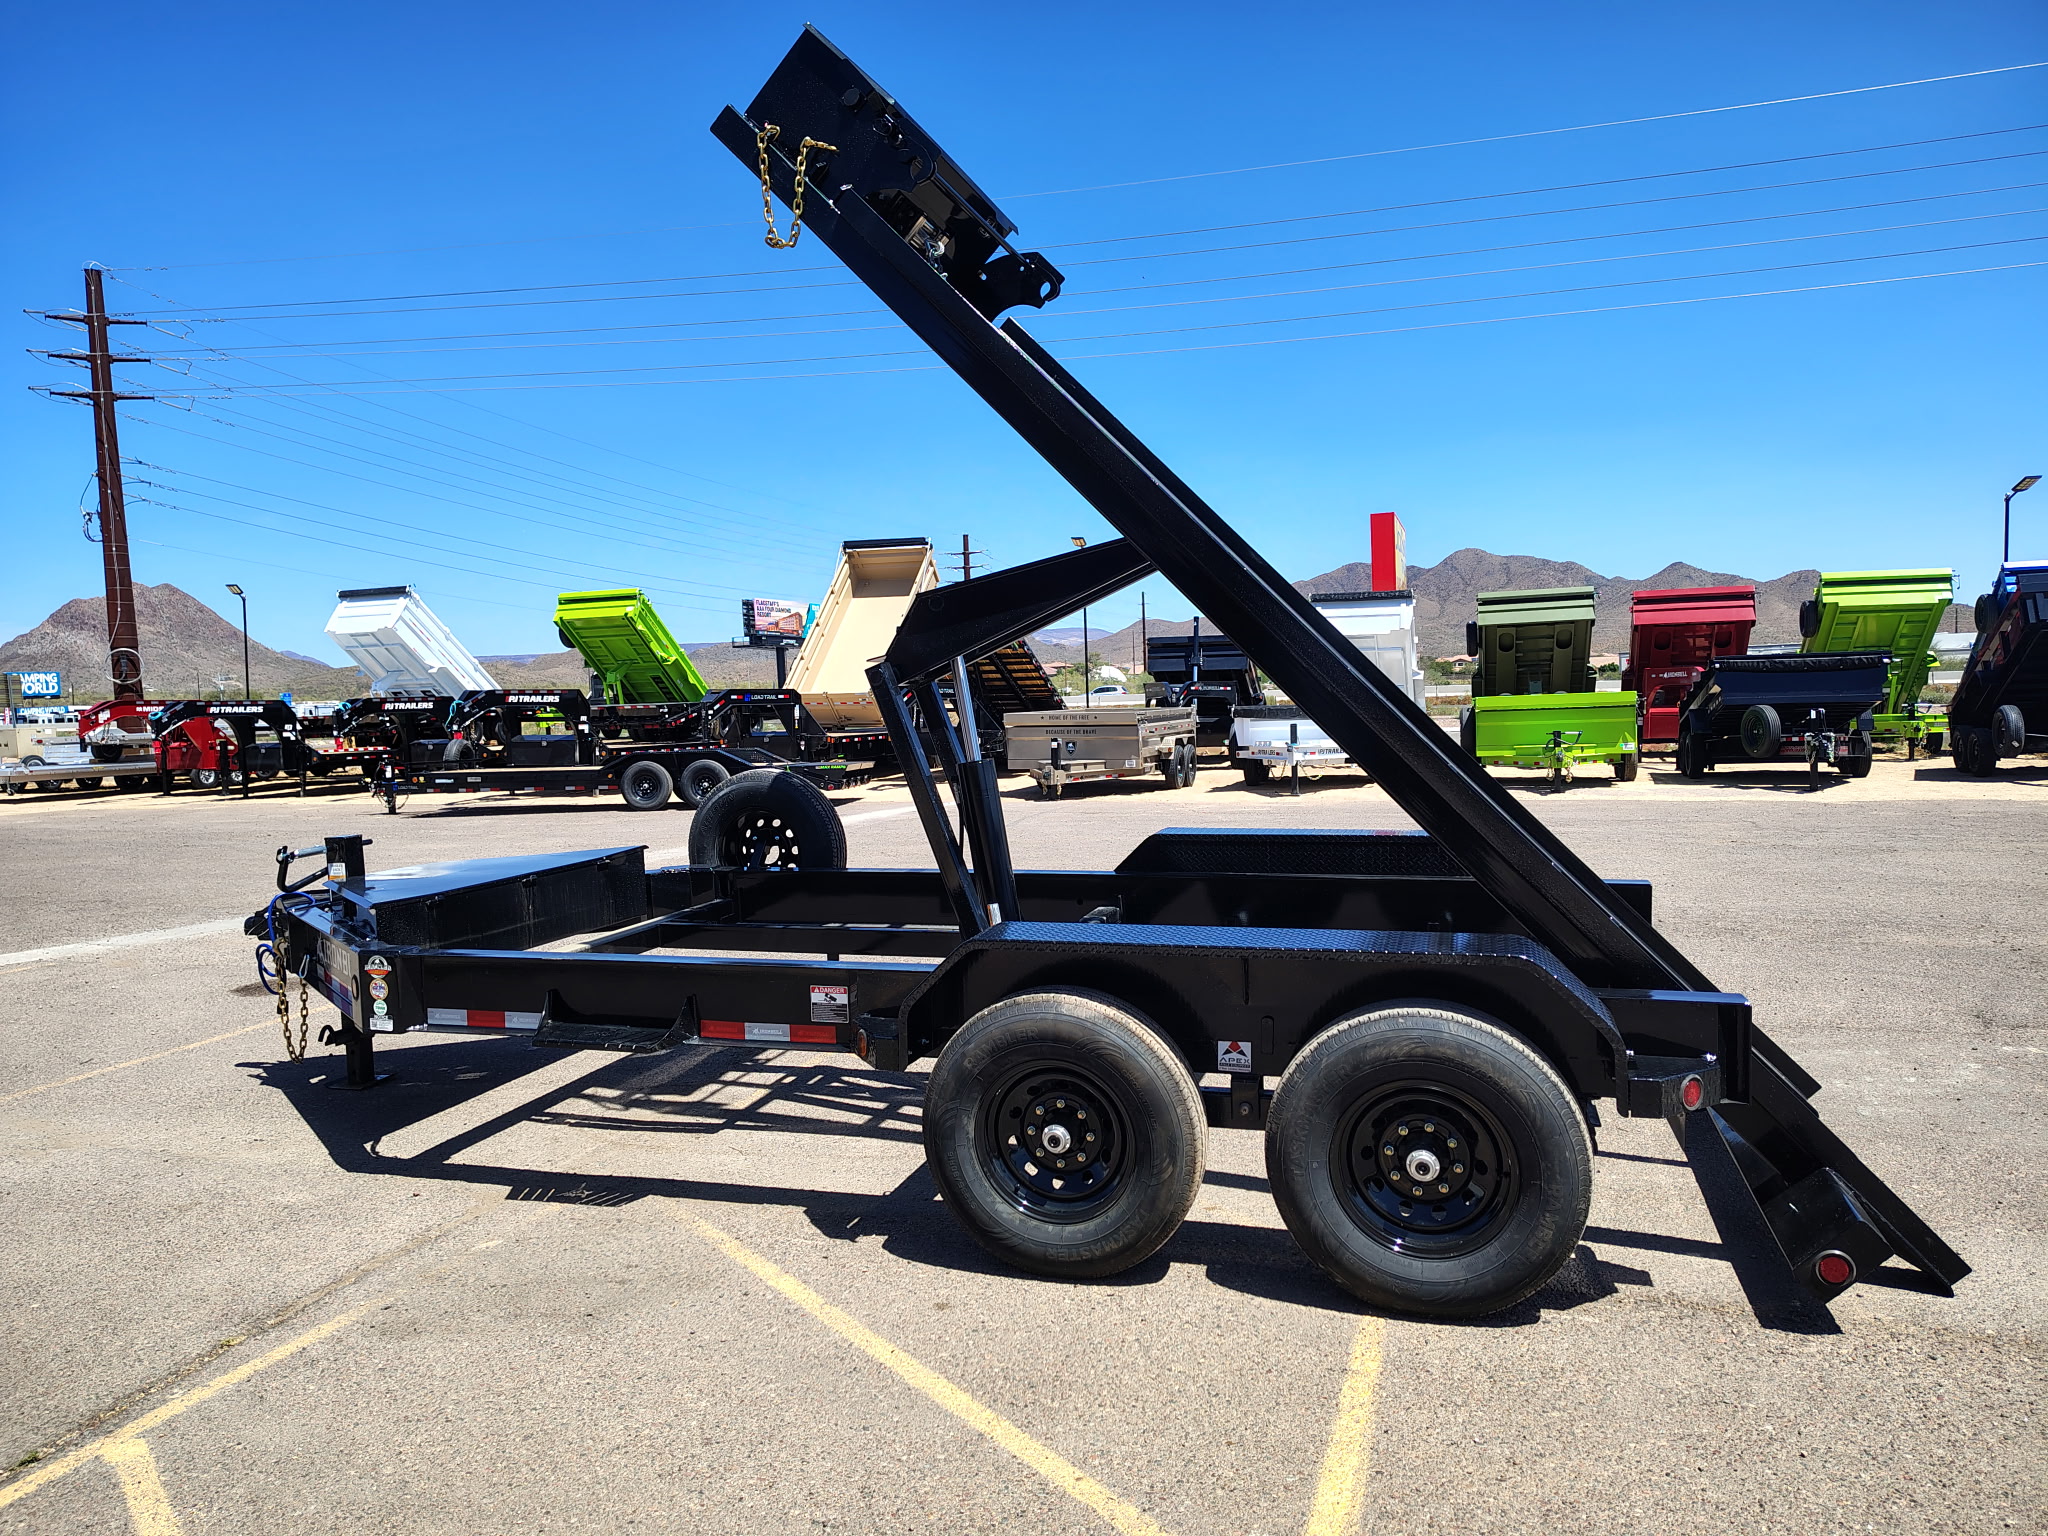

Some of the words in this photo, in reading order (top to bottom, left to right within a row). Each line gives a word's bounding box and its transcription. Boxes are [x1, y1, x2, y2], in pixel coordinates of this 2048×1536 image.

[20, 672, 58, 683] AMPING
[518, 695, 560, 703] TRAILERS
[220, 705, 264, 713] TRAILERS
[394, 701, 434, 710] TRAILERS
[963, 1027, 1039, 1070] RAMBLER
[1219, 1057, 1250, 1065] APEX
